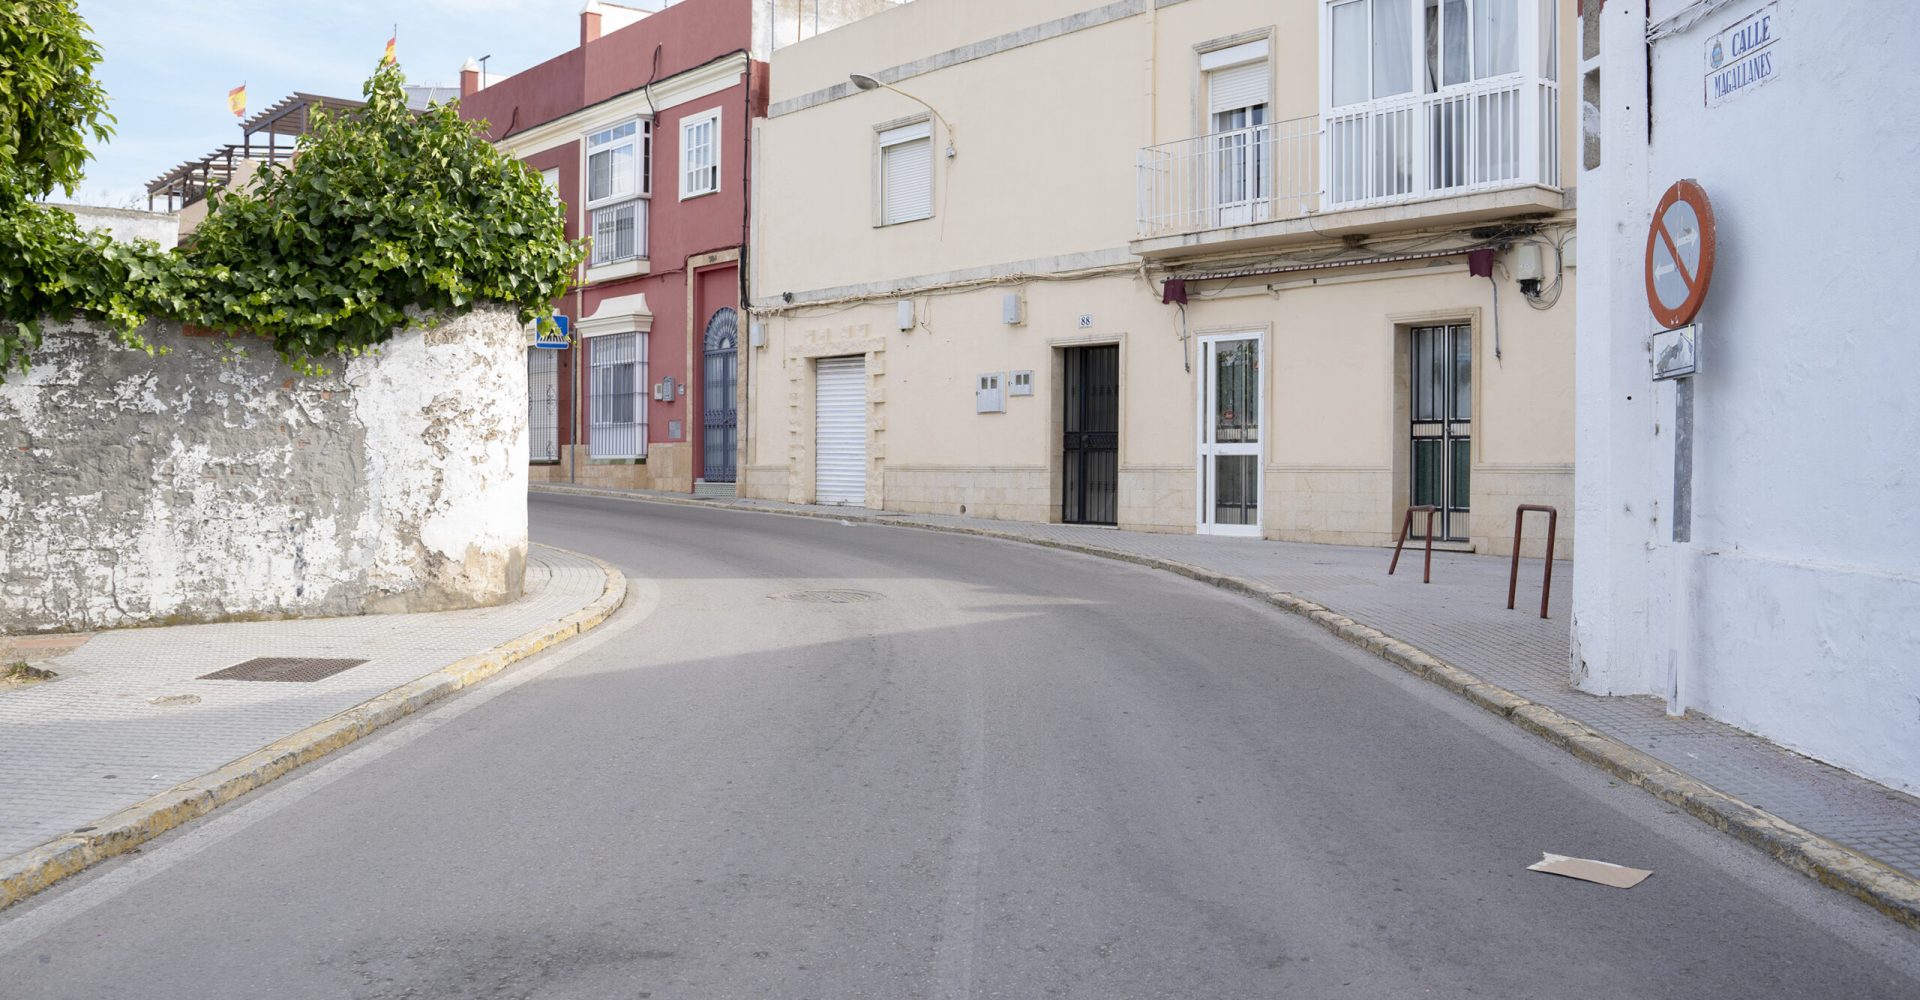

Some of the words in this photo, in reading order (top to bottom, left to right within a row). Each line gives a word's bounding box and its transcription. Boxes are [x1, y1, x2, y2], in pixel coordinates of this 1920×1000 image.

[1732, 15, 1771, 57] CALLE
[1714, 51, 1772, 99] MAGALLANES
[1080, 316, 1091, 326] 88
